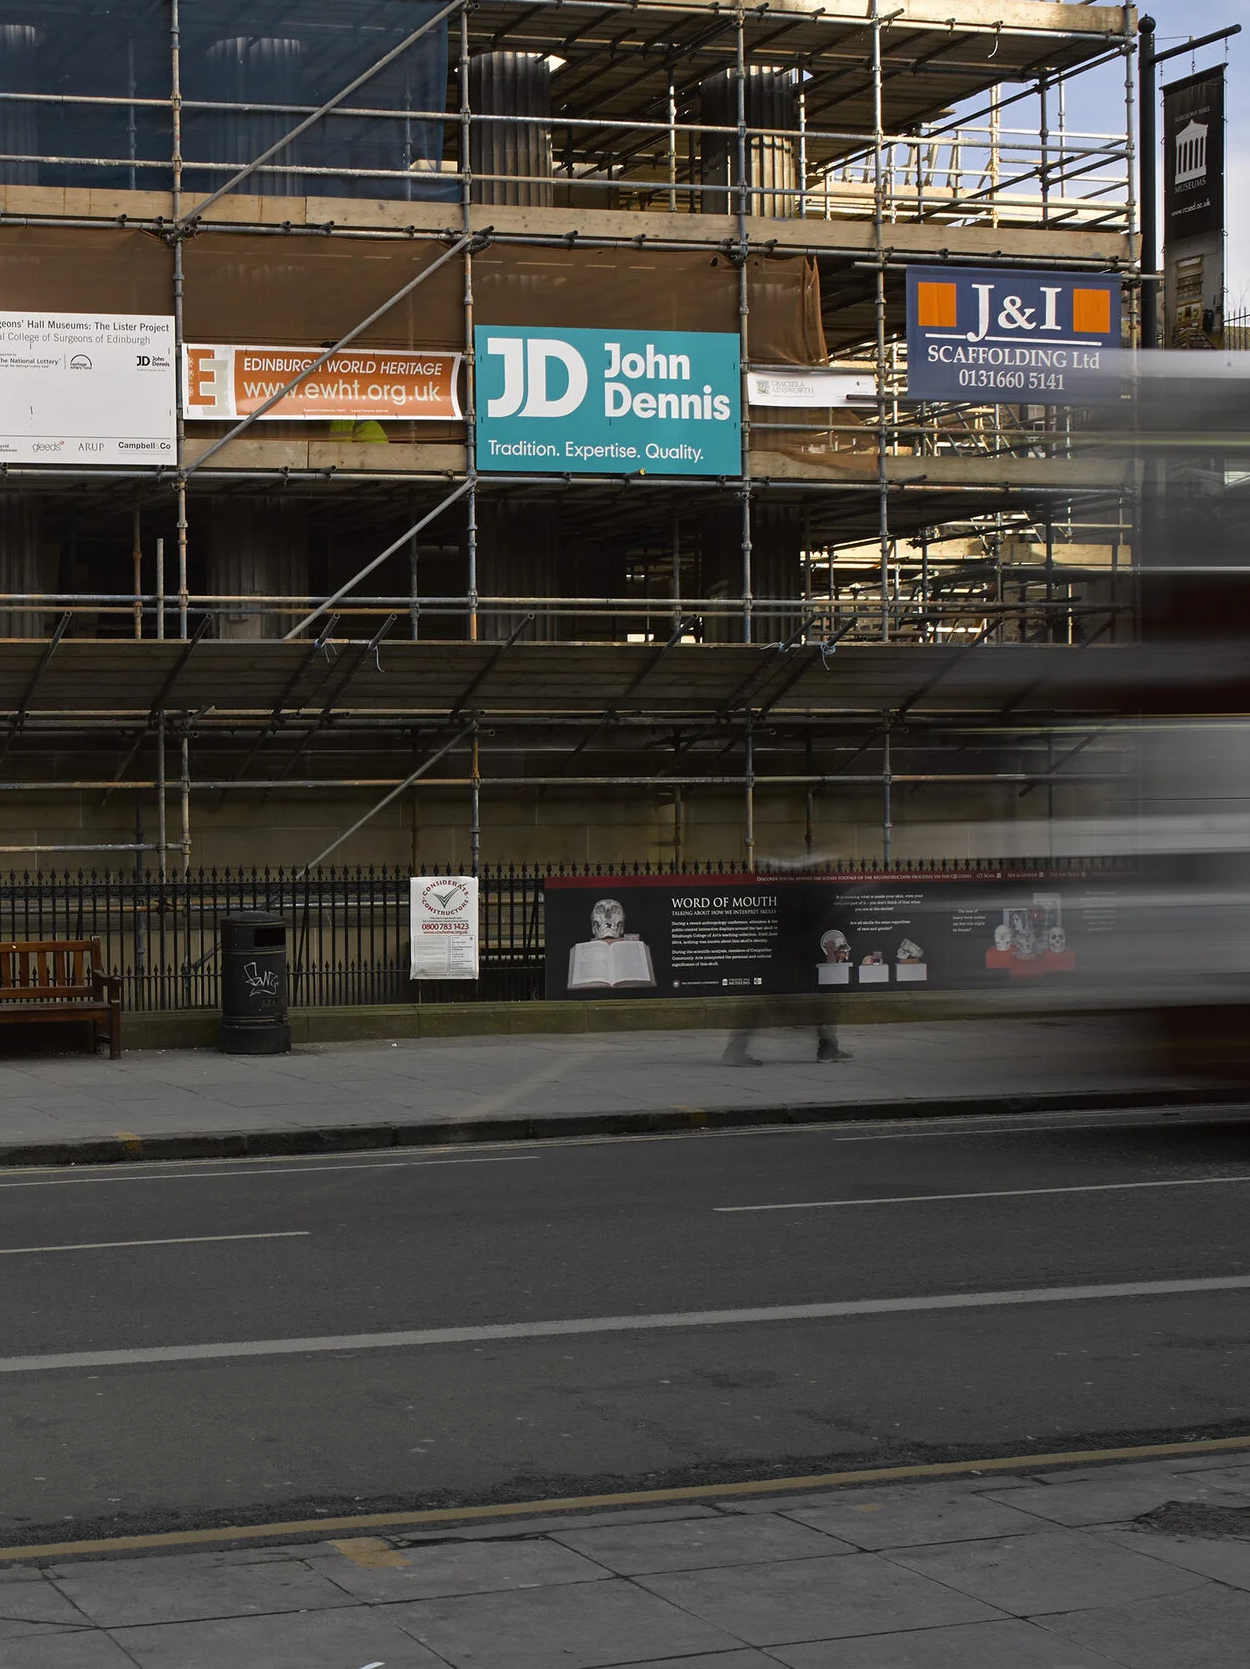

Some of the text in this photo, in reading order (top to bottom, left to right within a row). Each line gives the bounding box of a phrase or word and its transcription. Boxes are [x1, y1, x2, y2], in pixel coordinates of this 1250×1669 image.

[1174, 177, 1207, 194] MUSEUMS
[966, 283, 1062, 342] J&I
[27, 320, 44, 328] Hall
[47, 321, 91, 330] Museums:
[94, 322, 110, 330] The
[113, 322, 137, 331] Lister
[139, 323, 170, 333] Project
[7, 332, 39, 343] College
[42, 332, 50, 341] of
[53, 333, 93, 344] Surgeons
[95, 335, 104, 343] of
[107, 335, 151, 346] Edinburgh
[137, 356, 150, 366] JD
[604, 342, 690, 380] John
[928, 344, 1100, 369] SCAFFOLDING Ltd
[327, 360, 376, 374] WORLD
[380, 361, 442, 376] HERITAGE
[487, 337, 588, 418] JD
[958, 368, 1065, 389] 0131660 5141
[243, 379, 442, 406] www.ewht.org.uk
[604, 382, 731, 421] Dennis
[78, 443, 104, 451] ARUP
[488, 439, 704, 463] Tradition. Expertise. Quality.
[422, 880, 469, 896] CONSIDERATE
[422, 899, 469, 916] CONSTRUCTORS
[671, 896, 777, 908] WORD OF MOUTH
